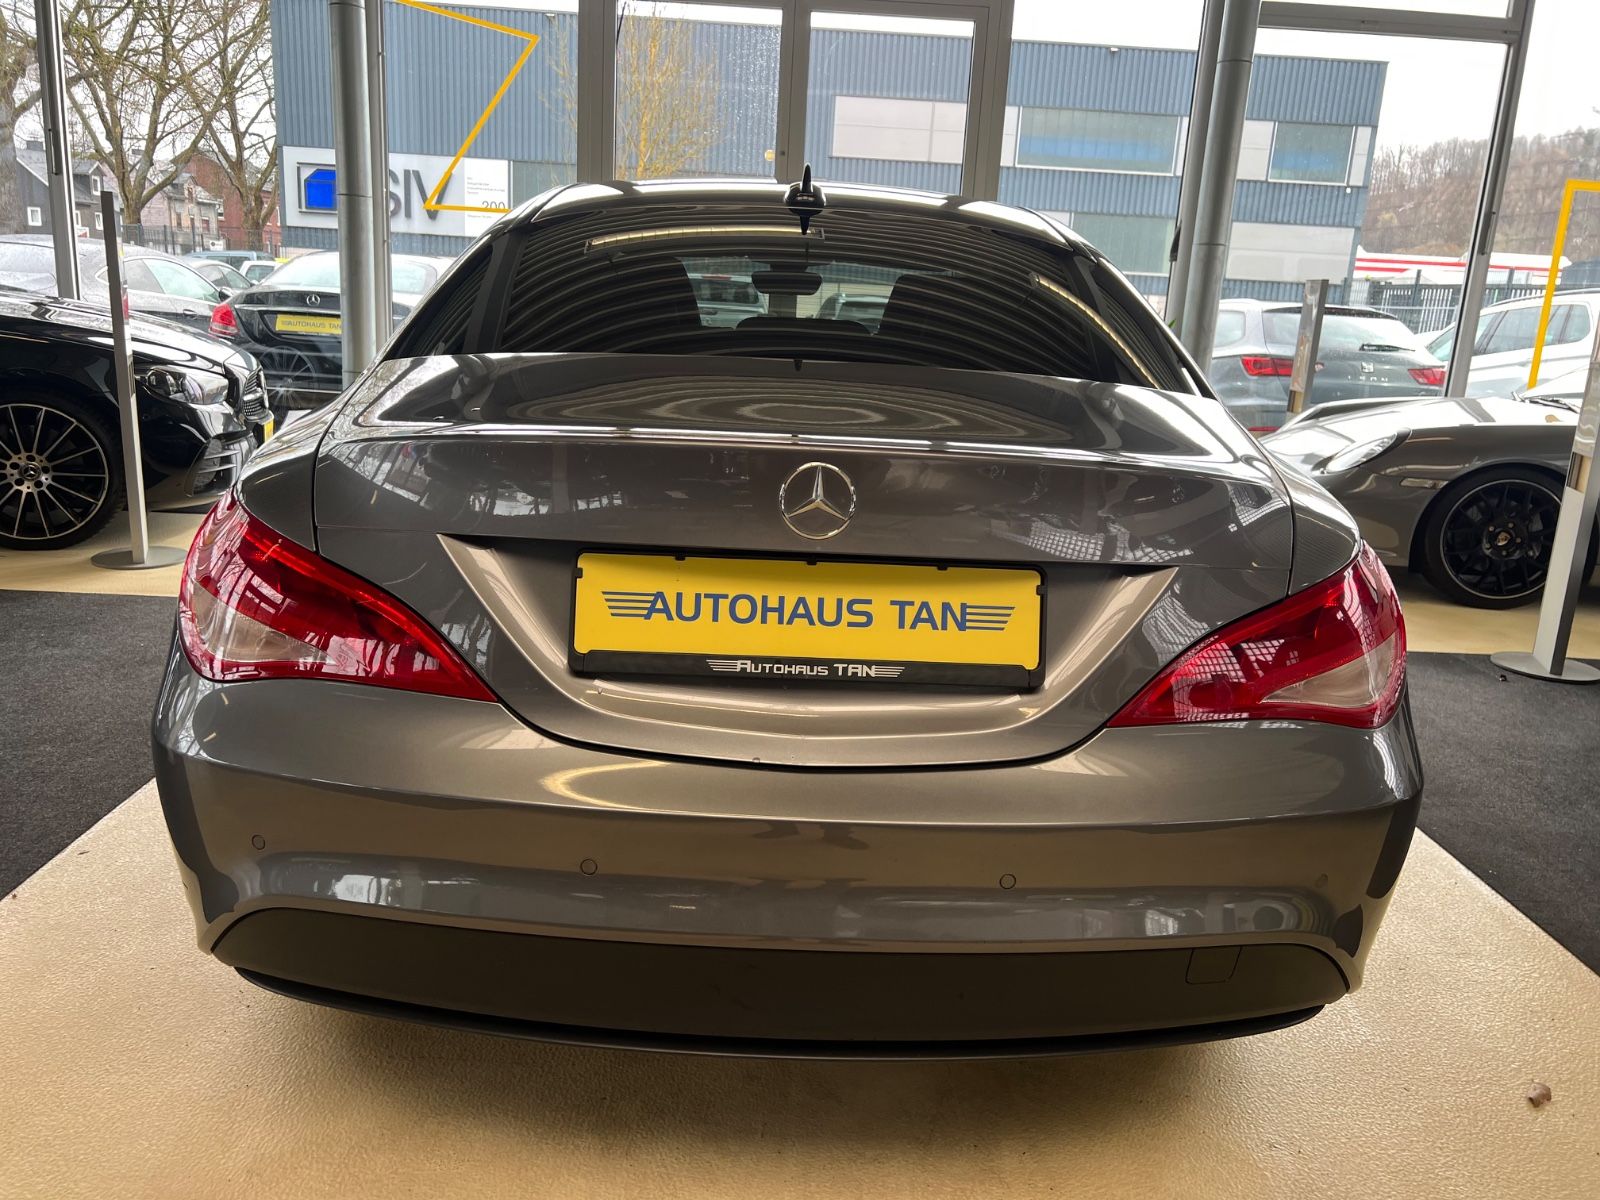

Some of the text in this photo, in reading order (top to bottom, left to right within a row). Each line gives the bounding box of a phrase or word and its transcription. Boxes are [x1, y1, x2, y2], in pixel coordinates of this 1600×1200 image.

[644, 591, 967, 632] AUTOHAUS TAN
[737, 660, 876, 677] AUTOHAUS TAN
